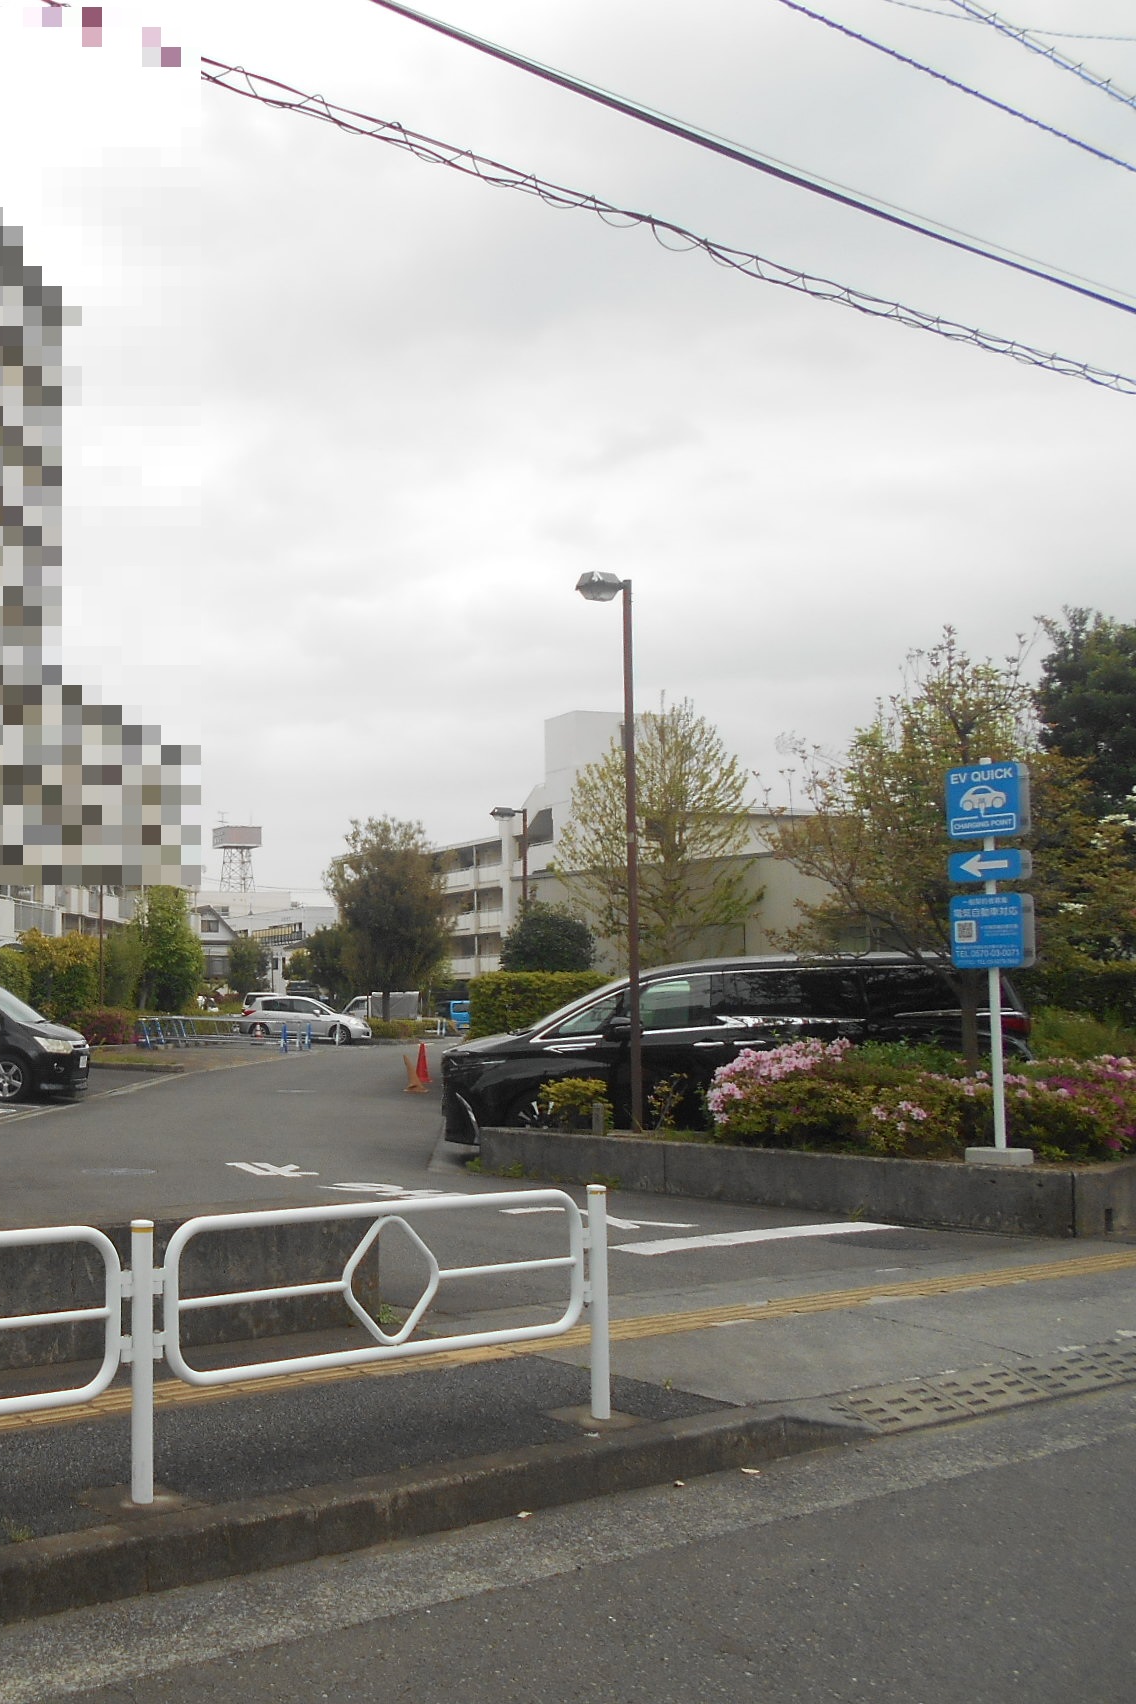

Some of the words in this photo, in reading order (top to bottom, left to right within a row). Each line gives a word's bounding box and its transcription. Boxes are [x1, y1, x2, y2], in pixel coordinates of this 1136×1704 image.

[950, 773, 967, 785] EV
[971, 767, 1013, 782] QUICK
[953, 820, 990, 830] CHARGING
[990, 818, 1012, 827] POINT
[953, 906, 1018, 918] 電気自動車対応
